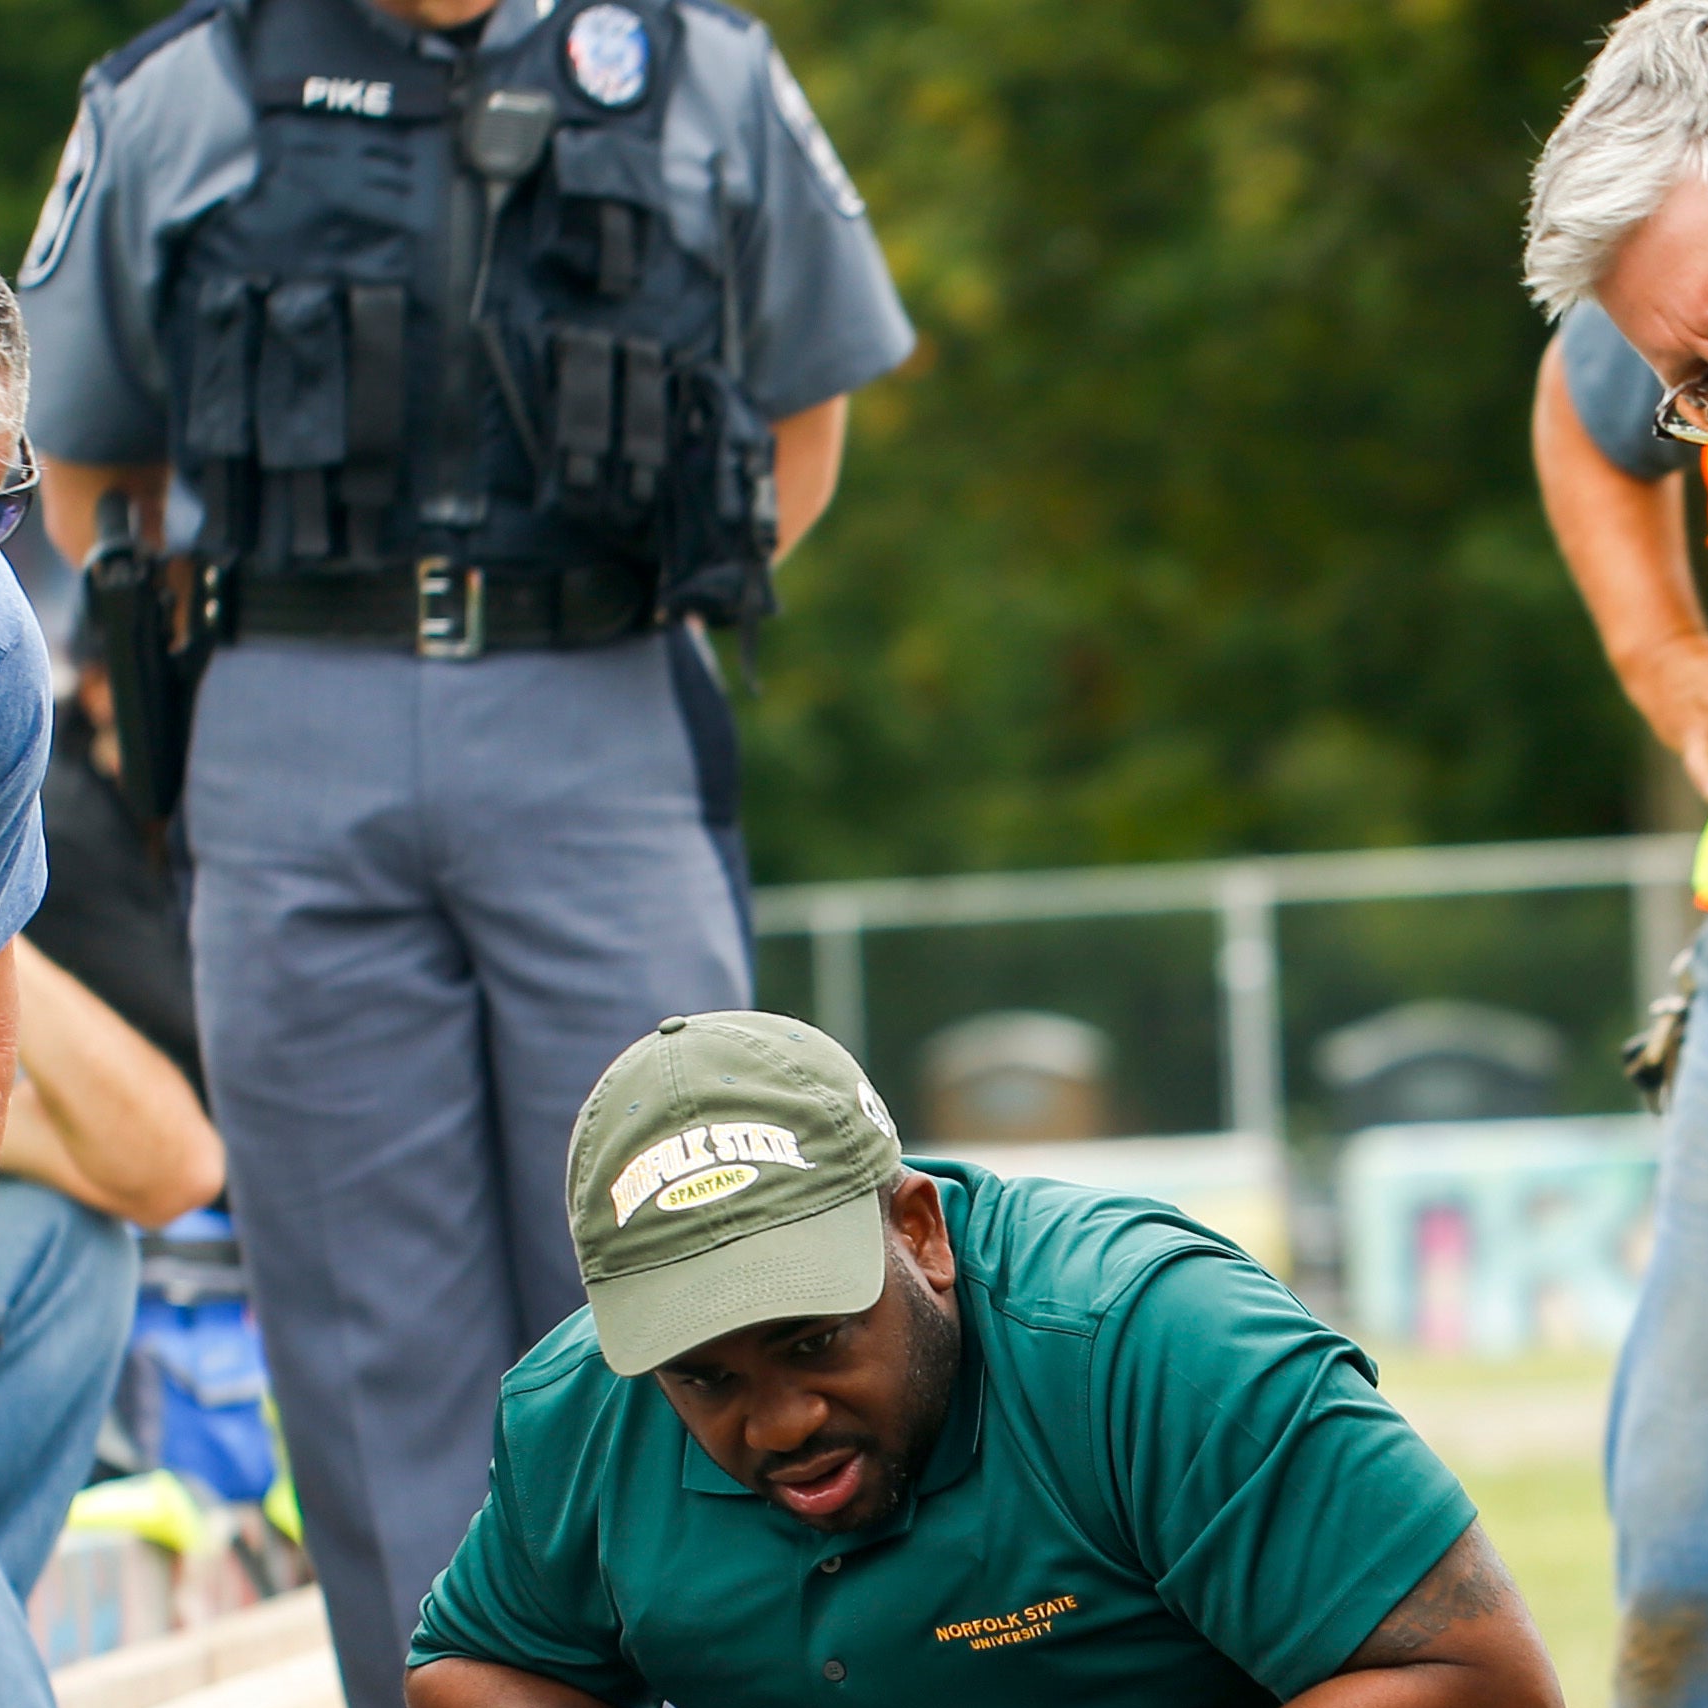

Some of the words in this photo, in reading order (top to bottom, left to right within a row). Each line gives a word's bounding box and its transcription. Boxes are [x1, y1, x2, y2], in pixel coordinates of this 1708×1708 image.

[302, 75, 392, 117] PIKE
[610, 1126, 716, 1229] NORFOLK
[709, 1122, 808, 1171] STATE
[668, 1169, 746, 1206] SPARTANS
[935, 1612, 1023, 1642] NORFOLK
[1023, 1594, 1078, 1621] STATE
[969, 1620, 1052, 1650] UNIVERSITY
